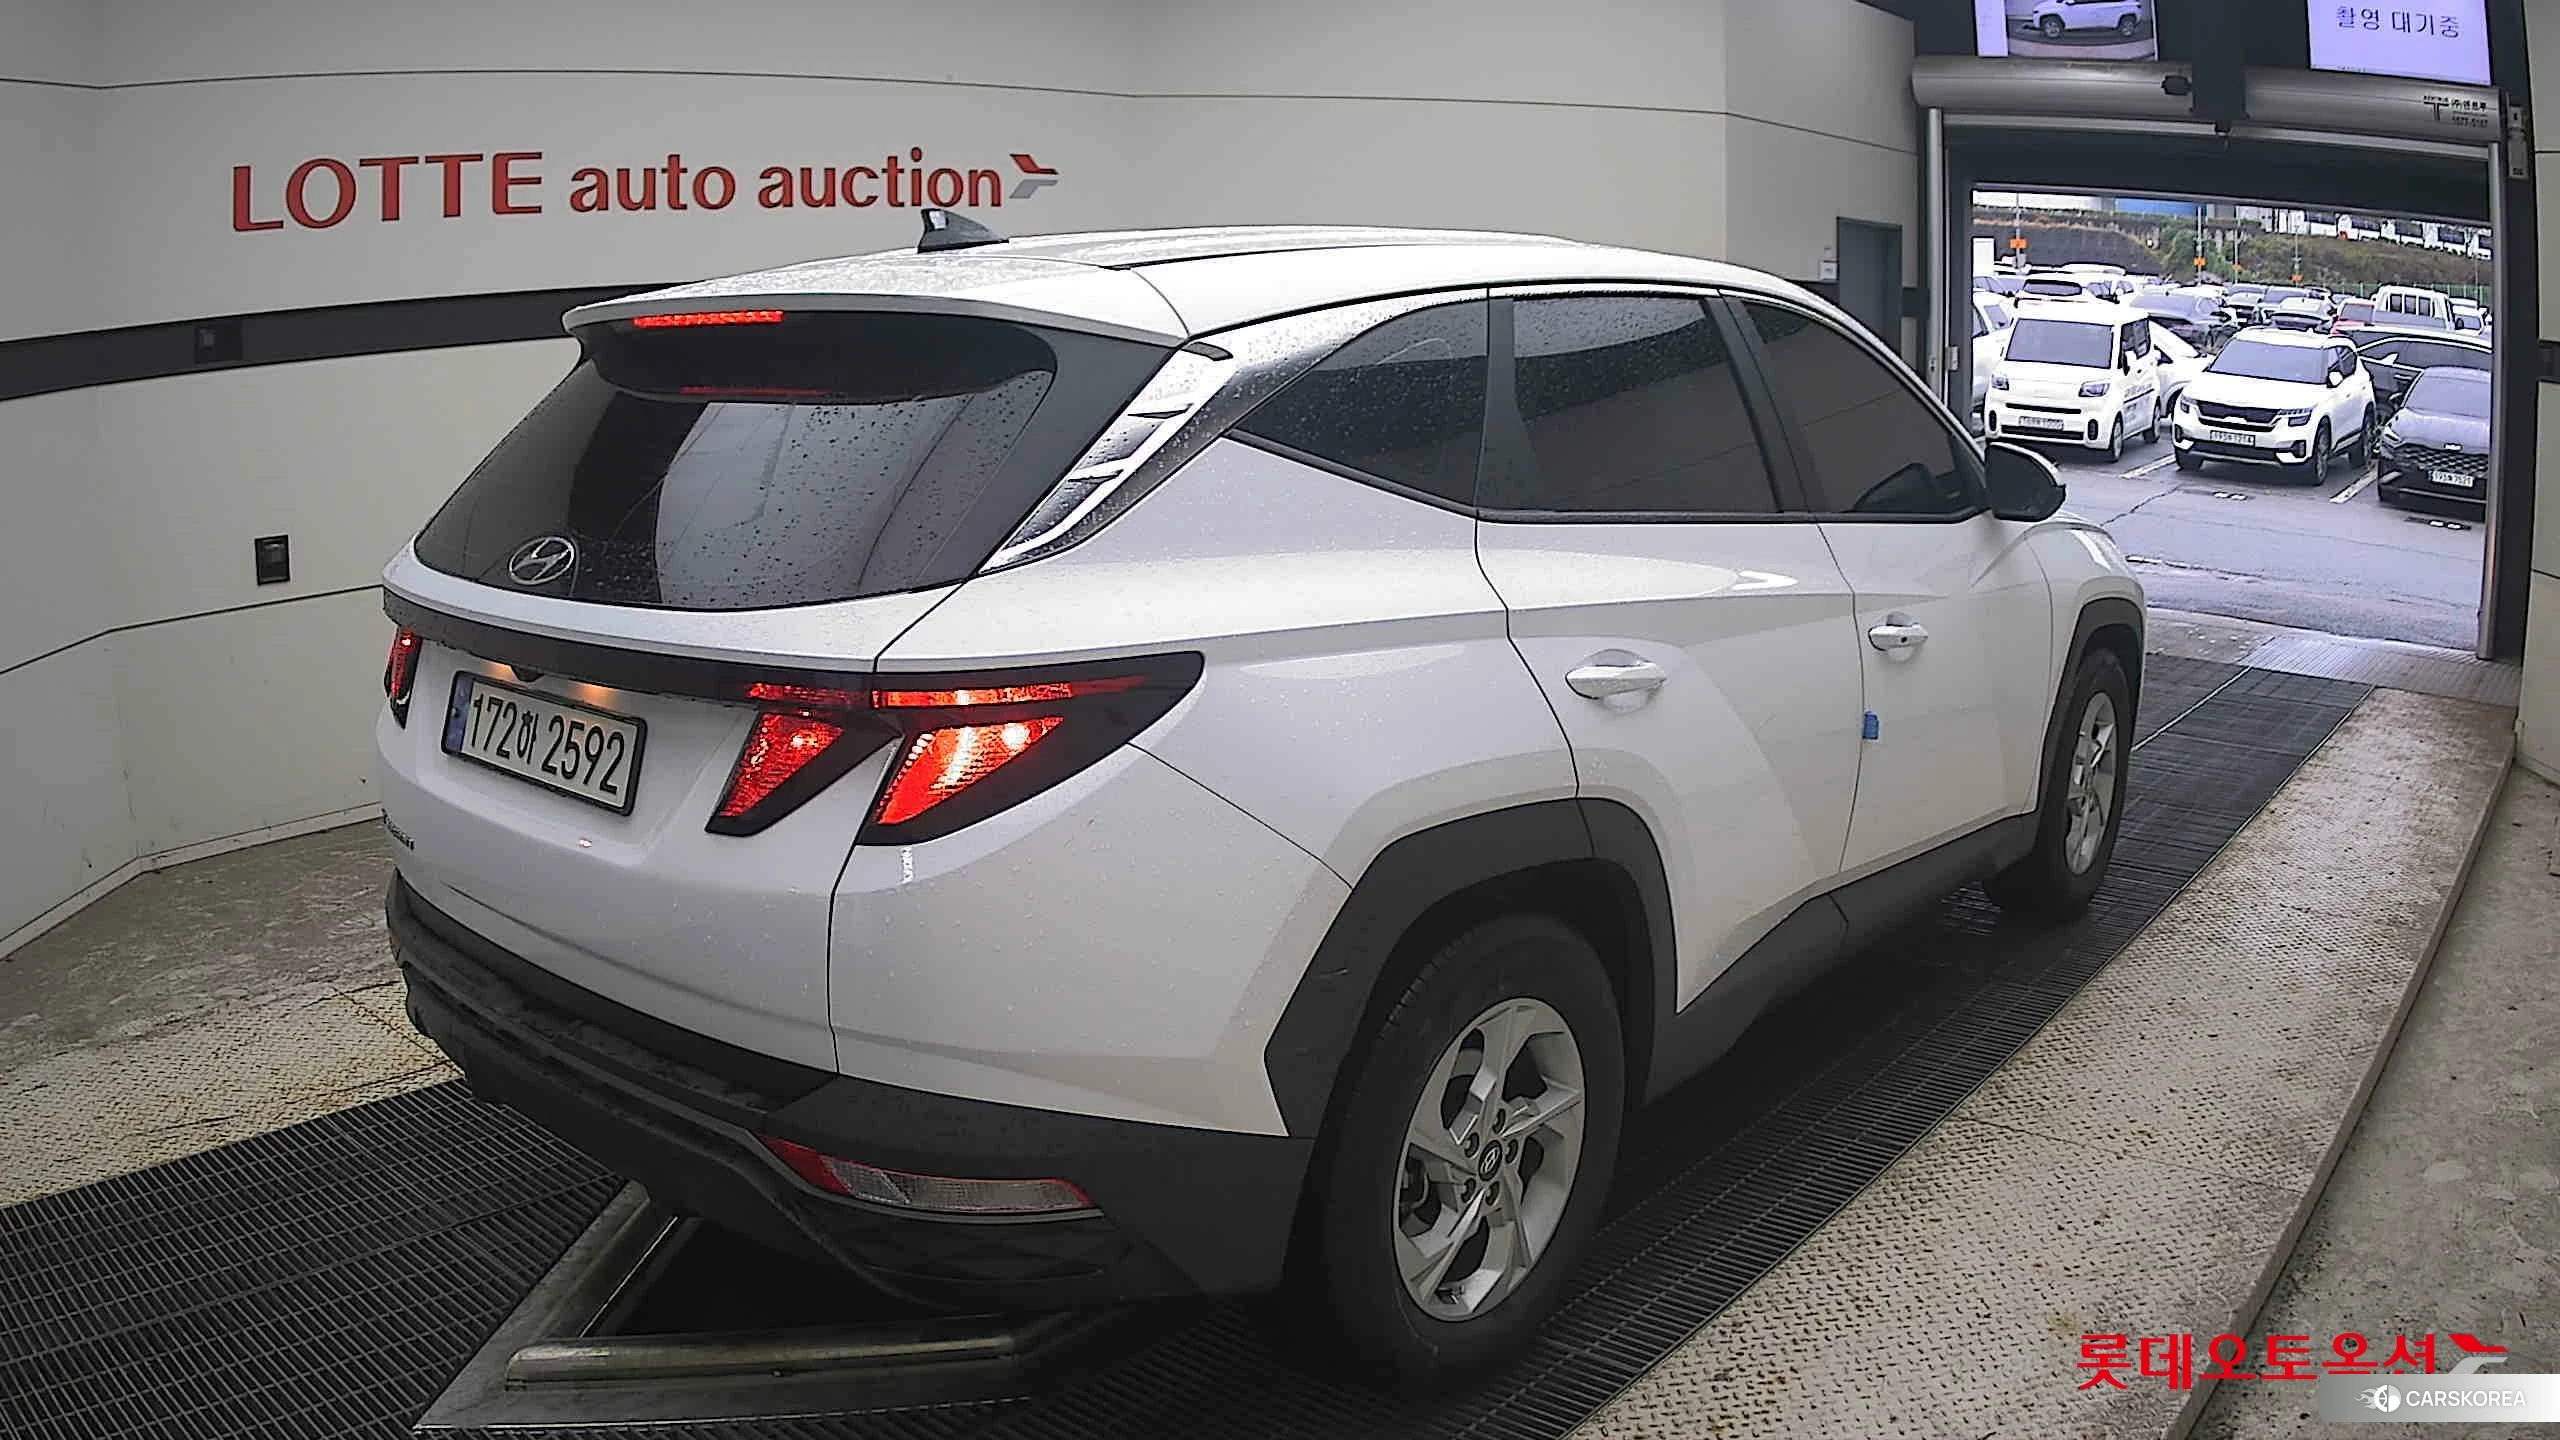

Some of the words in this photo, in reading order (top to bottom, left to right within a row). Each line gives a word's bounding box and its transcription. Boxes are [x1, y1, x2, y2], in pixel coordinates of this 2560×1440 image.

[2336, 6, 2380, 31] 촬영
[2391, 11, 2459, 38] 대기중
[231, 152, 543, 232] LOTTE
[568, 154, 736, 211] auto
[759, 146, 1002, 209] auction
[470, 693, 539, 765] 172하
[541, 714, 627, 796] 2592
